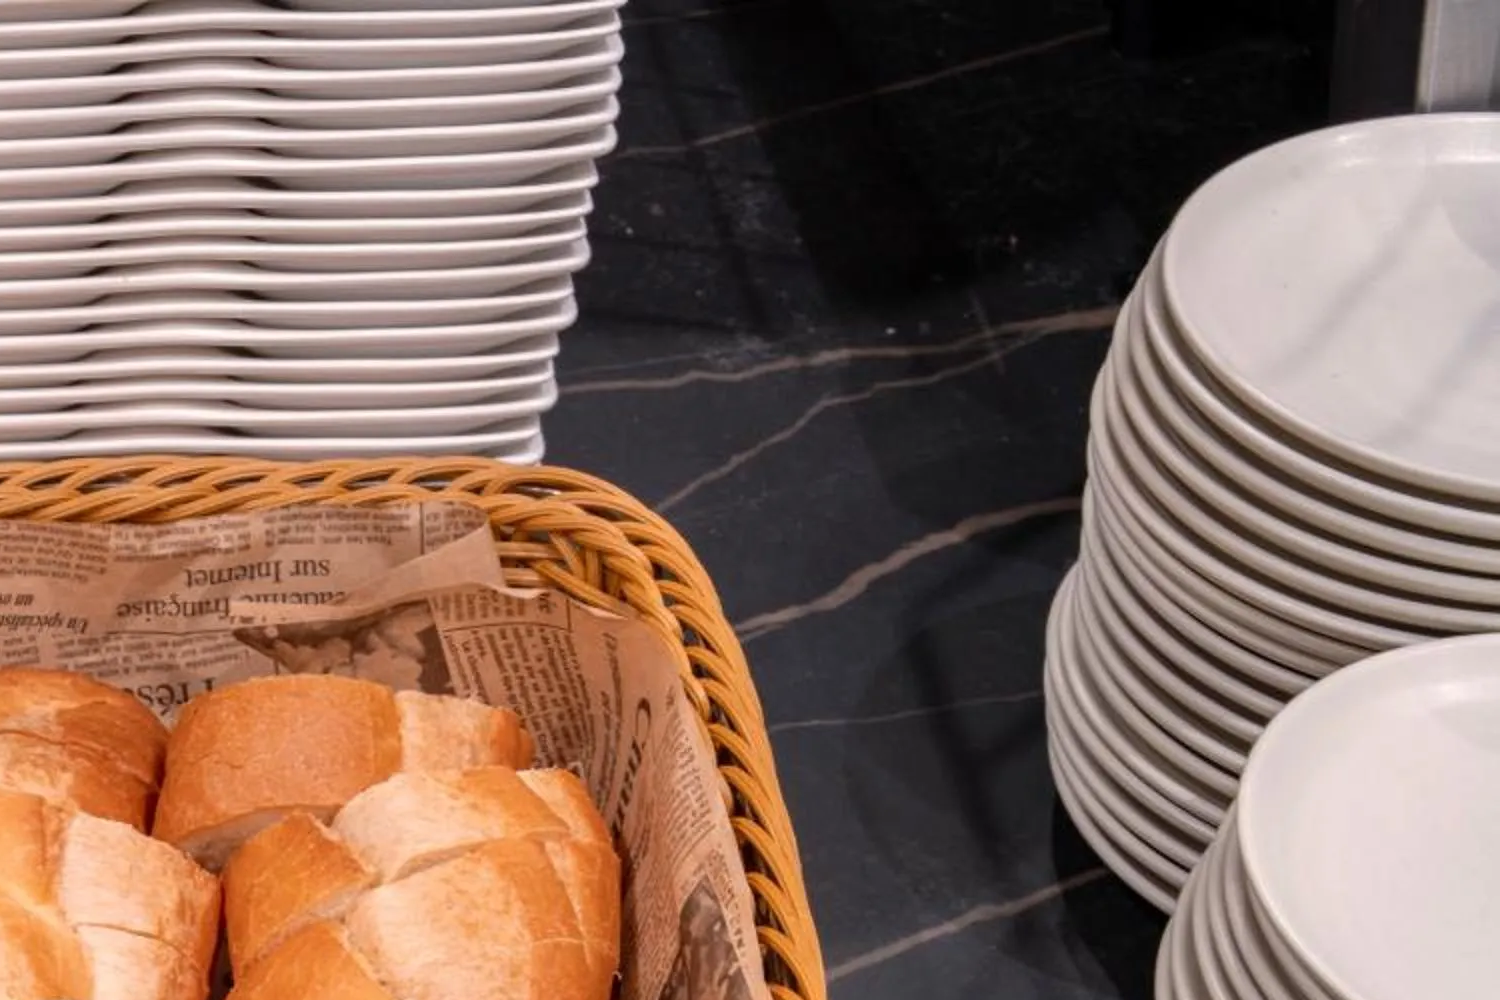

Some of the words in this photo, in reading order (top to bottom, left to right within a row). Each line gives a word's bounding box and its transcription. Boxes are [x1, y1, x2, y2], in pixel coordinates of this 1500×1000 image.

[183, 559, 283, 590] Internet
[289, 558, 331, 578] sur
[116, 592, 231, 623] française
[122, 678, 214, 716] rés
